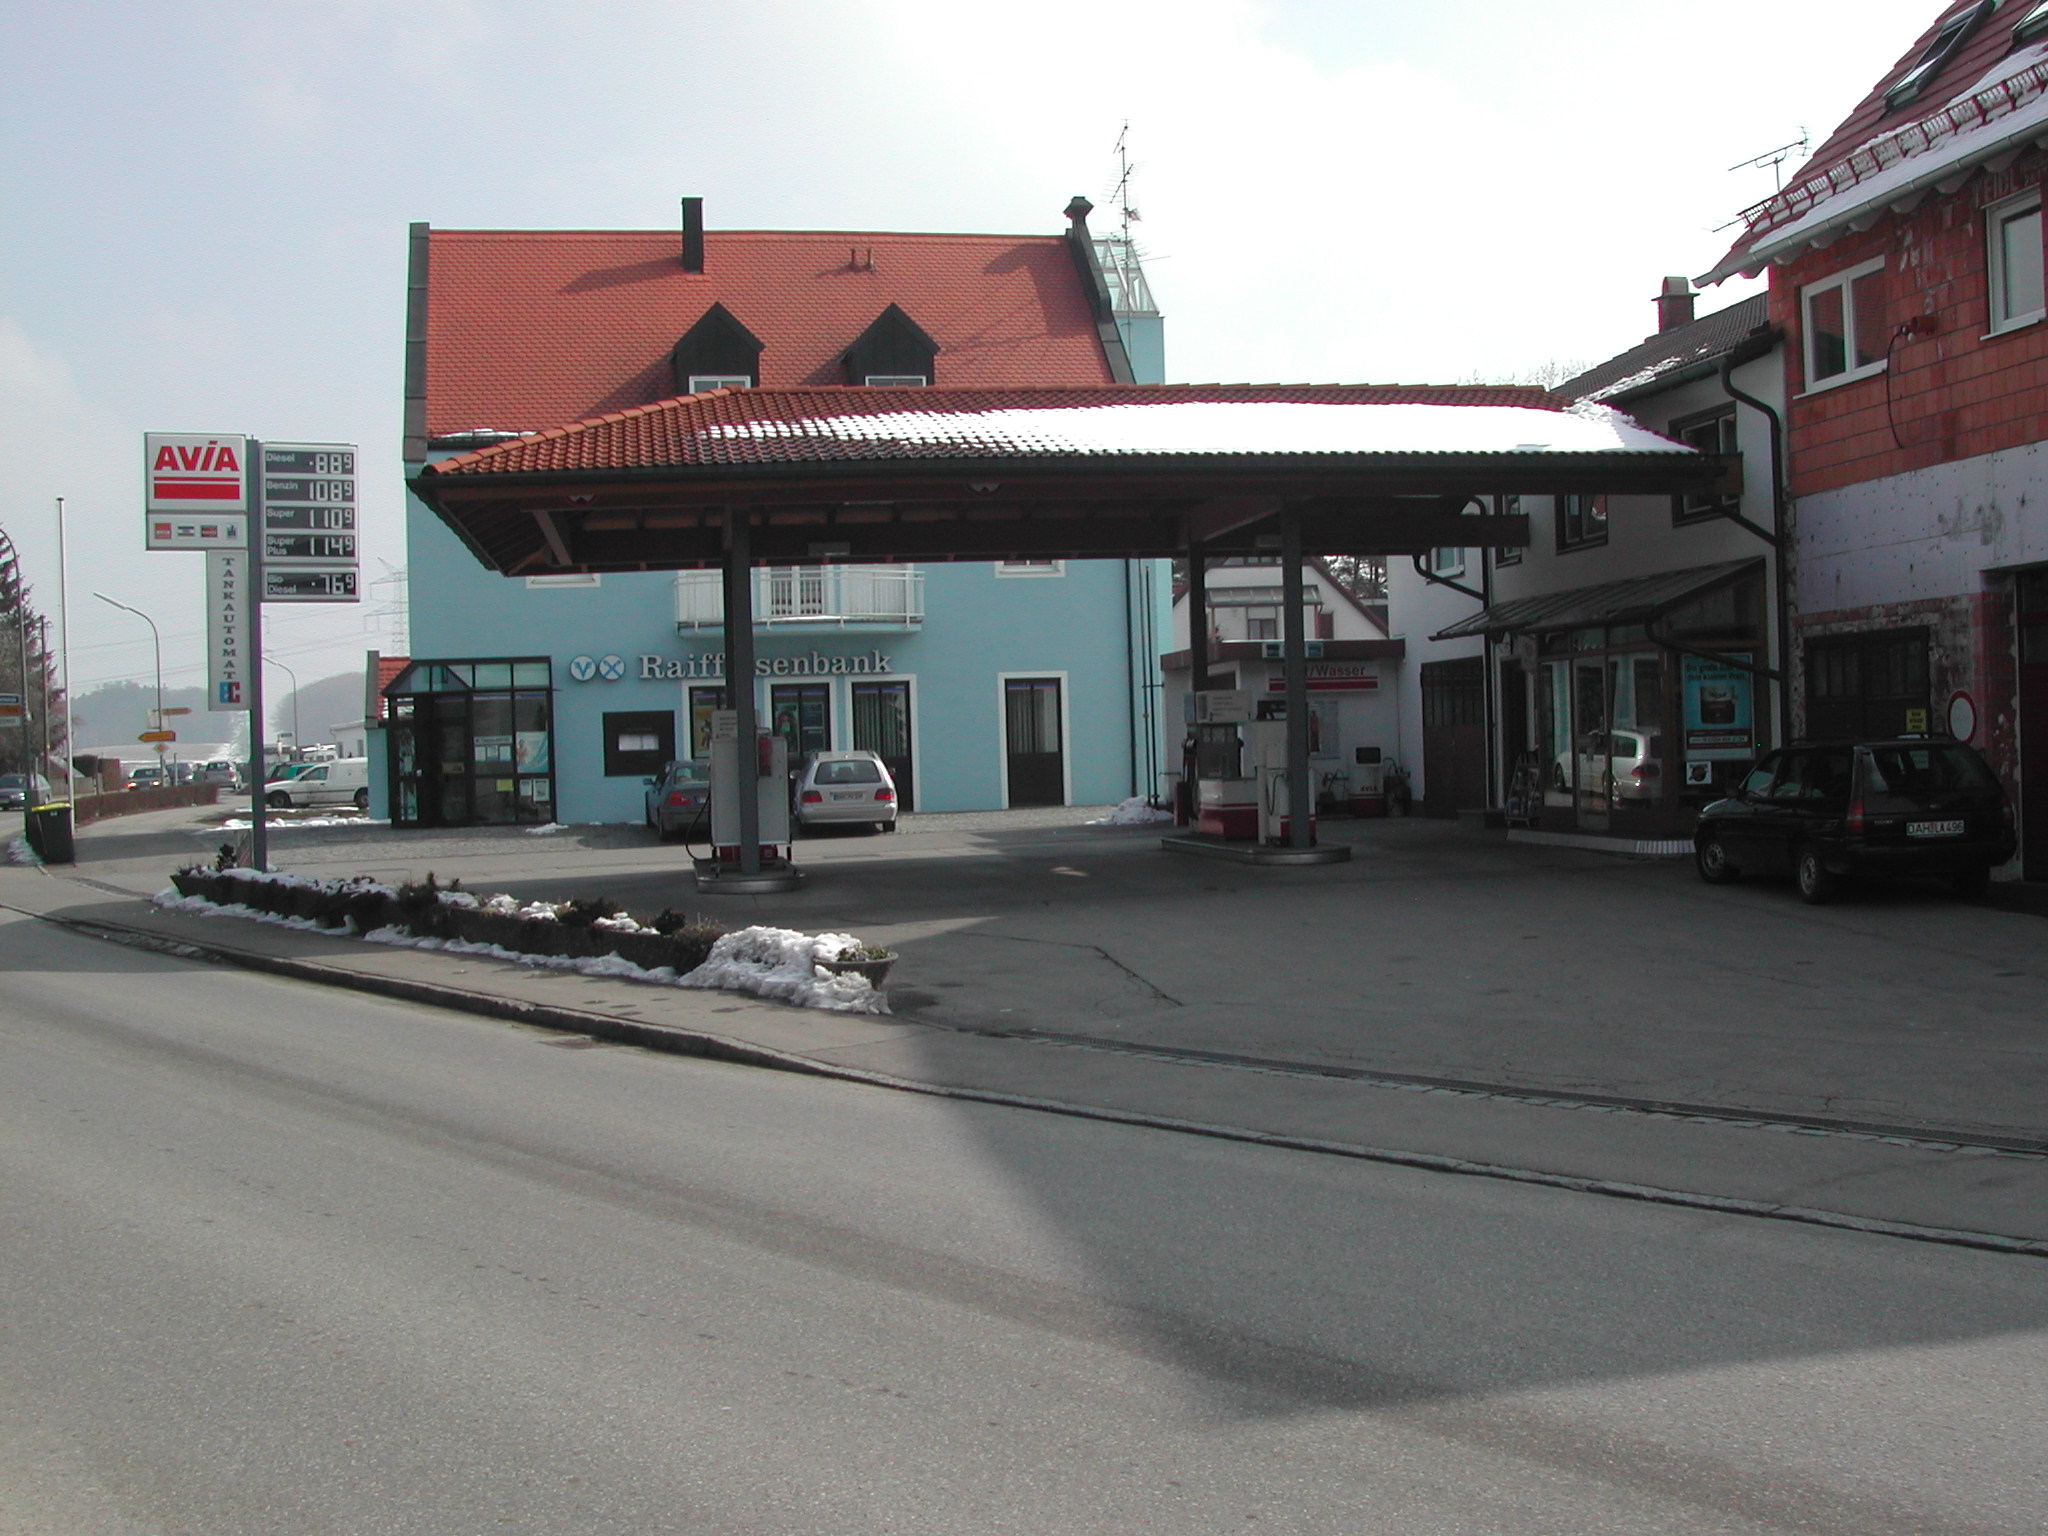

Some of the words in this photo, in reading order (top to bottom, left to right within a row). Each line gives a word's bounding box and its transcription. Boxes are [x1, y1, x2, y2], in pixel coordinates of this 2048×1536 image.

[266, 453, 295, 462] Diesel
[266, 480, 298, 490] Benzin
[309, 480, 353, 501] 1089
[266, 508, 295, 519] Super
[267, 536, 295, 546] Super
[267, 547, 287, 555] Plus
[268, 574, 283, 583] Bio
[268, 585, 296, 594] Diesel
[221, 557, 237, 680] TANKAUTOMAT
[639, 649, 895, 680] Raiffsenbank
